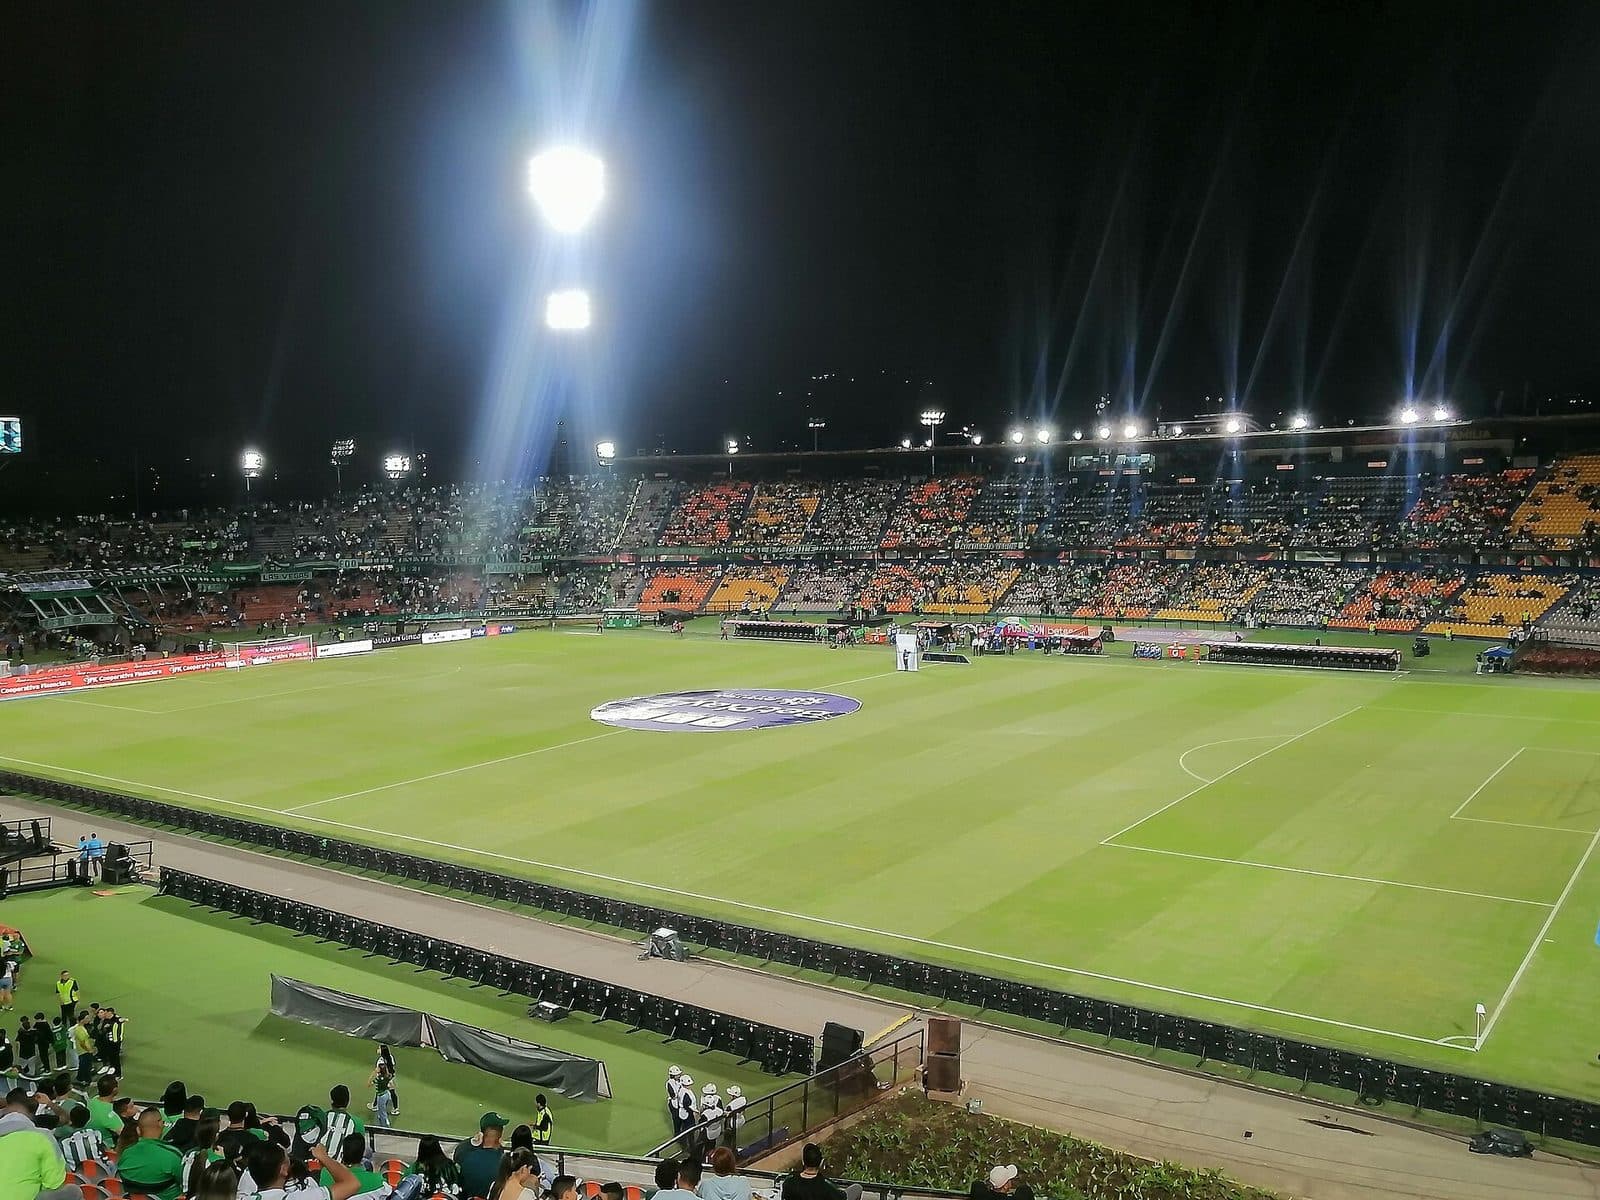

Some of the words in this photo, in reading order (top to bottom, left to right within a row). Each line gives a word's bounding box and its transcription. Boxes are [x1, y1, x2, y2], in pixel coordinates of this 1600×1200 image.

[283, 572, 309, 580] VEGAS
[99, 673, 133, 682] Cooperativa
[0, 684, 39, 694] Cooperativa
